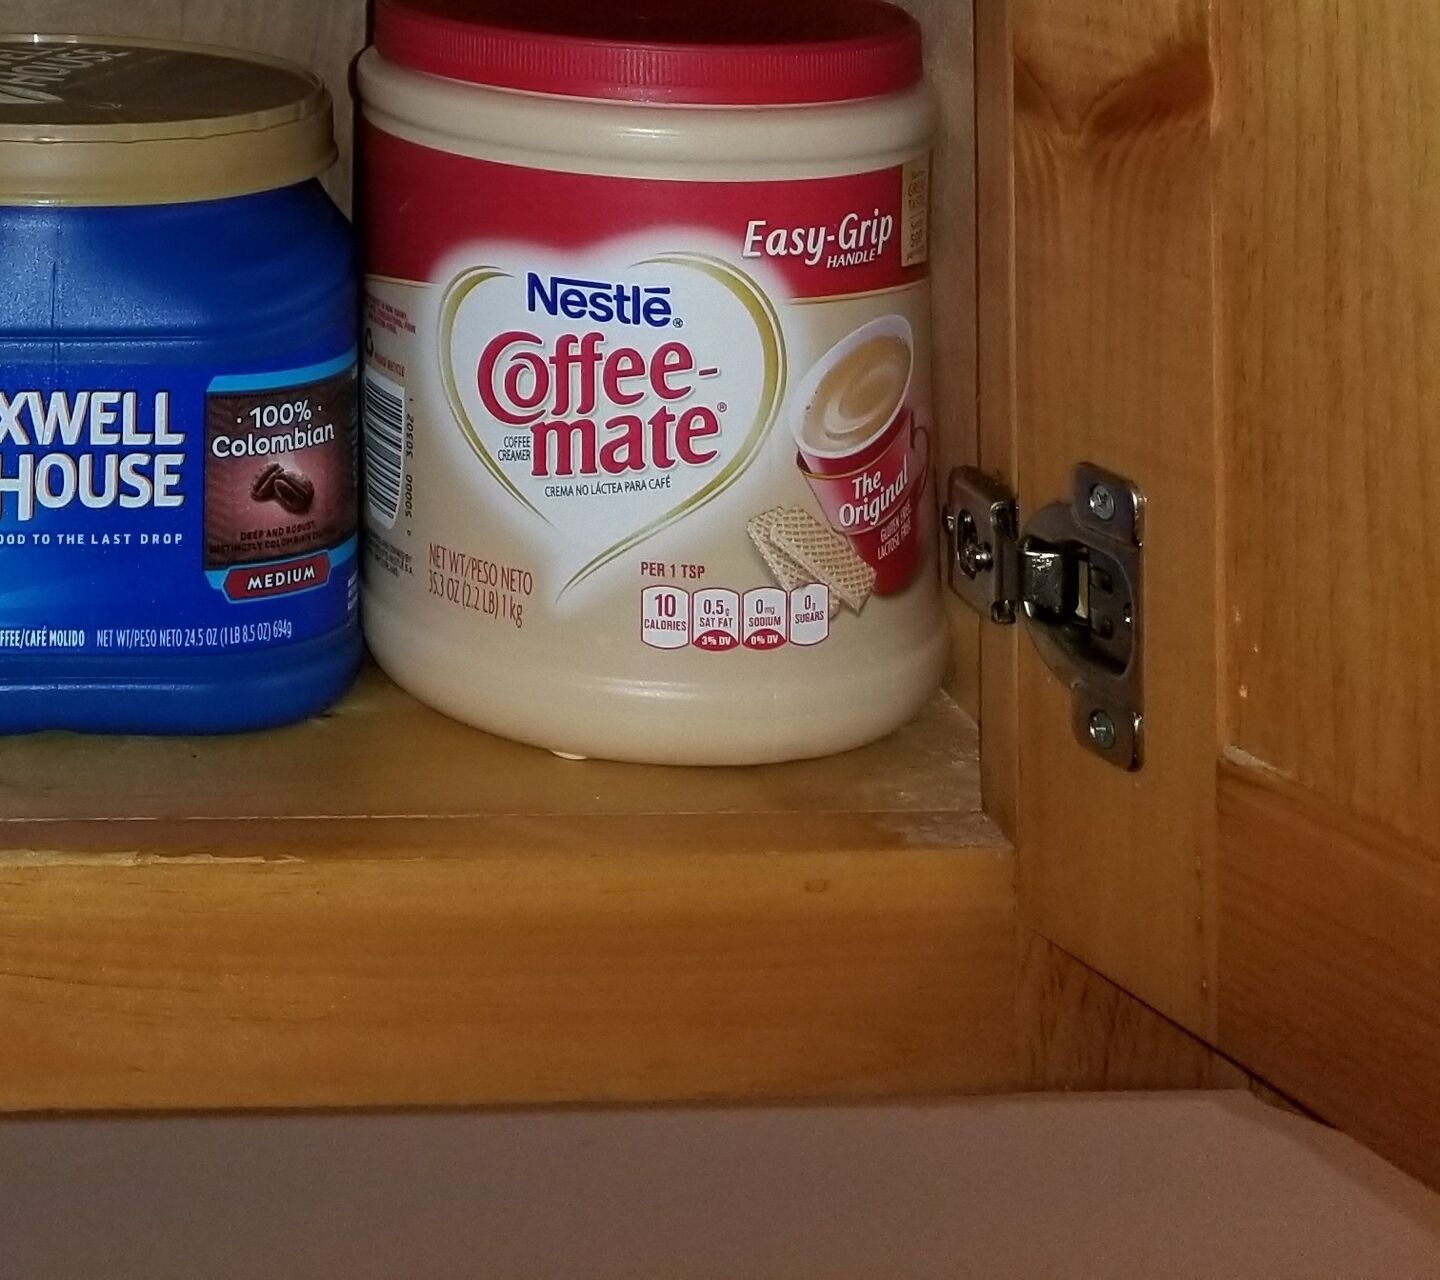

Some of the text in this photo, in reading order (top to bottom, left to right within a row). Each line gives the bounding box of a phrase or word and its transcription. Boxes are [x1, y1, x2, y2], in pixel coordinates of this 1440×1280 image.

[743, 208, 893, 265] Easy-Grip
[827, 249, 877, 269] HANDLE
[249, 399, 312, 429] 100%
[212, 423, 335, 458] Colombian
[503, 436, 531, 448] COFFEE
[530, 405, 719, 476] mate
[497, 449, 531, 461] CREAMER
[545, 474, 671, 497] CREMA NO LÁCTEA PARA CAFÉ
[840, 454, 908, 527] Original
[852, 471, 882, 499] The
[33, 534, 50, 545] TO
[57, 534, 84, 545] THE
[91, 534, 131, 545] LAST
[140, 533, 183, 545] DROP
[240, 528, 264, 541] DEEP
[266, 526, 285, 538] AND
[247, 565, 315, 591] MEDIUM
[428, 542, 447, 570] NET
[448, 550, 498, 587] WT/PESO
[501, 566, 533, 595] NETO
[640, 561, 706, 579] PER 1 TSP
[446, 578, 461, 604] OZ
[462, 580, 480, 610] (2.2
[482, 588, 499, 620] LB)
[502, 594, 507, 617] 1
[509, 595, 523, 629] kg
[654, 593, 677, 618] 10
[644, 618, 687, 631] CALORIES
[699, 617, 733, 628] SAT FAT
[748, 616, 781, 628] SODIUM
[795, 610, 825, 625] SUGARS
[49, 629, 85, 647] MOLIDO
[97, 628, 114, 648] NET
[116, 628, 157, 649] WT/PESO
[159, 628, 183, 648] NETO
[184, 628, 204, 648] 24.5
[206, 627, 218, 646] OZ
[230, 626, 241, 645] LB
[242, 624, 255, 643] 8.5
[257, 622, 272, 642] OZ)
[273, 618, 293, 639] 694g
[701, 635, 731, 646] 3% DV
[750, 634, 778, 646] 0% DV
